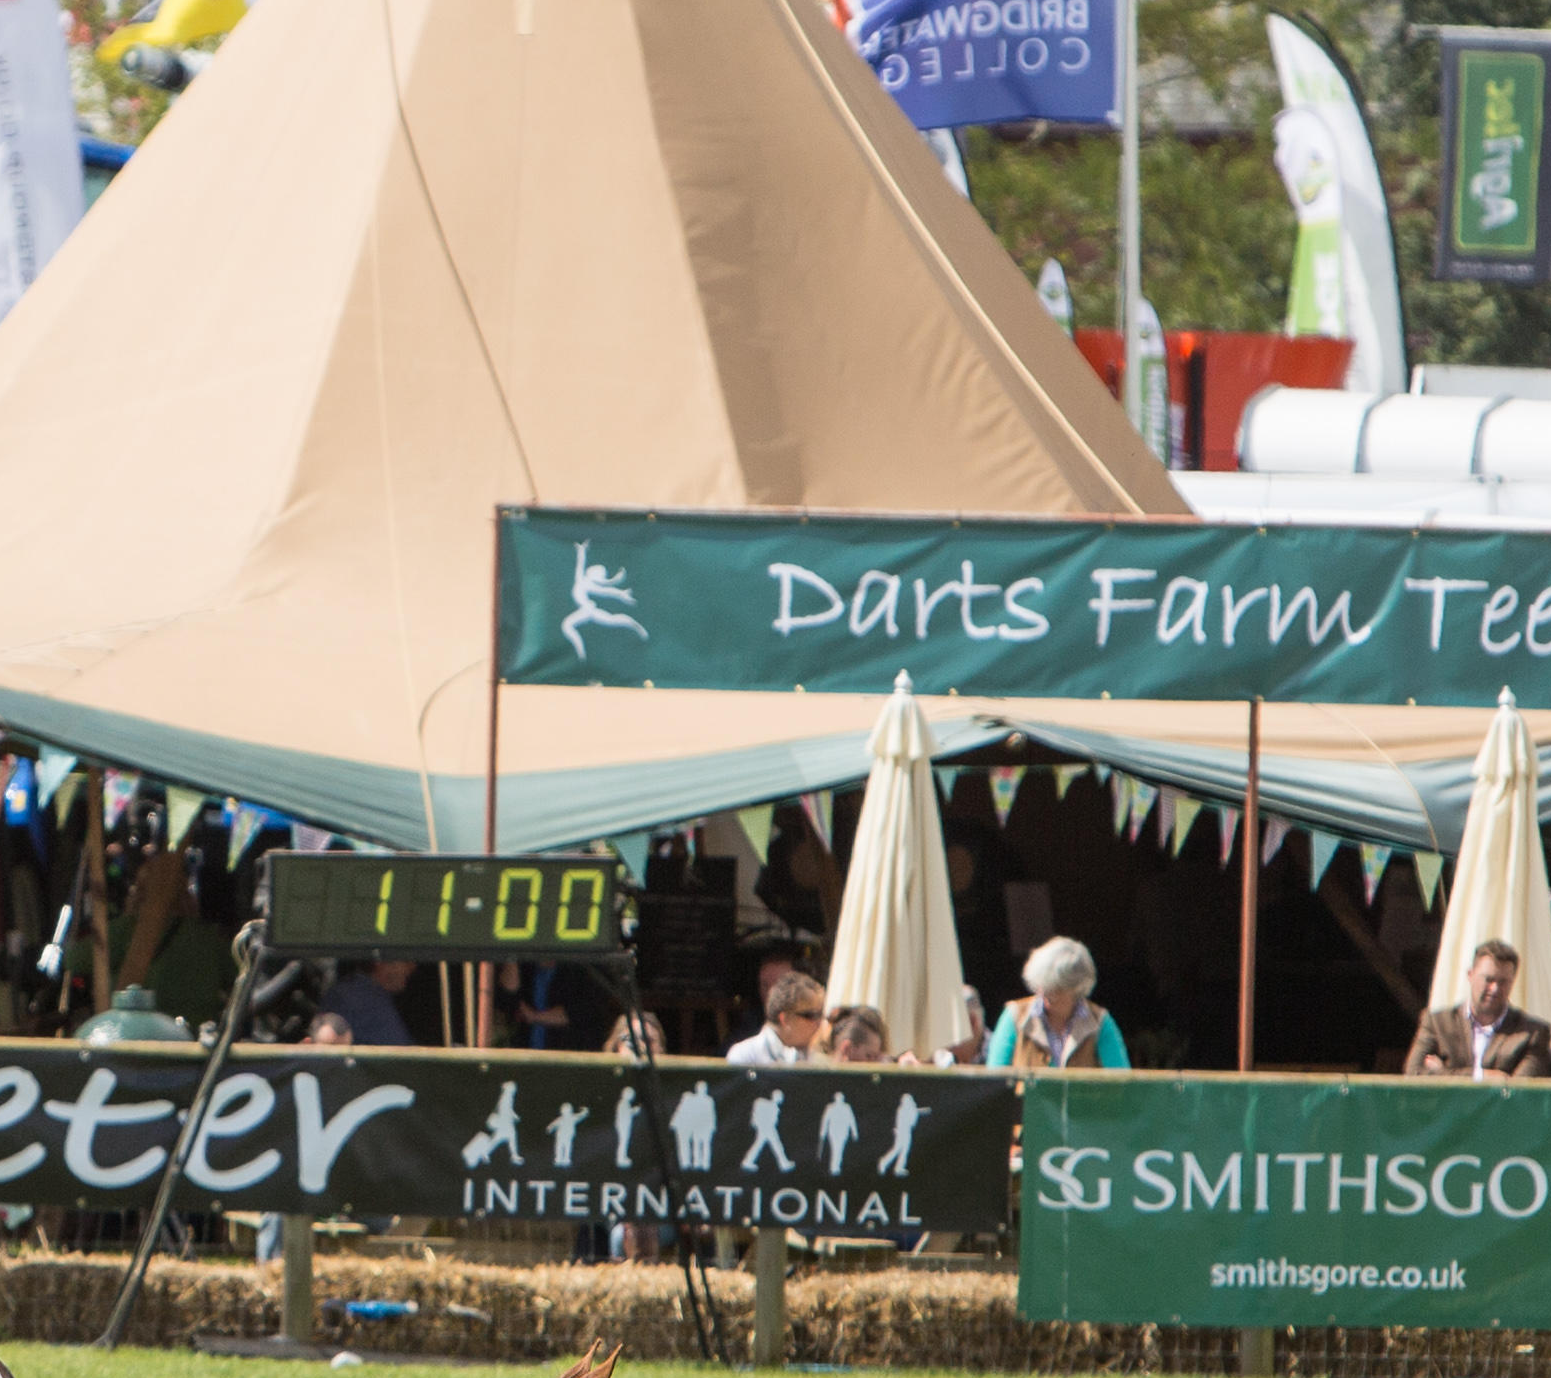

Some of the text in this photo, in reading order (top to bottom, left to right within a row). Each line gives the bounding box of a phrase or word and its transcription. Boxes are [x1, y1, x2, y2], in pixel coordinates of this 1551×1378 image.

[766, 558, 1052, 644] Darts
[1088, 568, 1372, 651] Farm
[462, 1178, 923, 1225] INTERNATIONAL
[1210, 1257, 1467, 1295] smithsgore.co.uk
